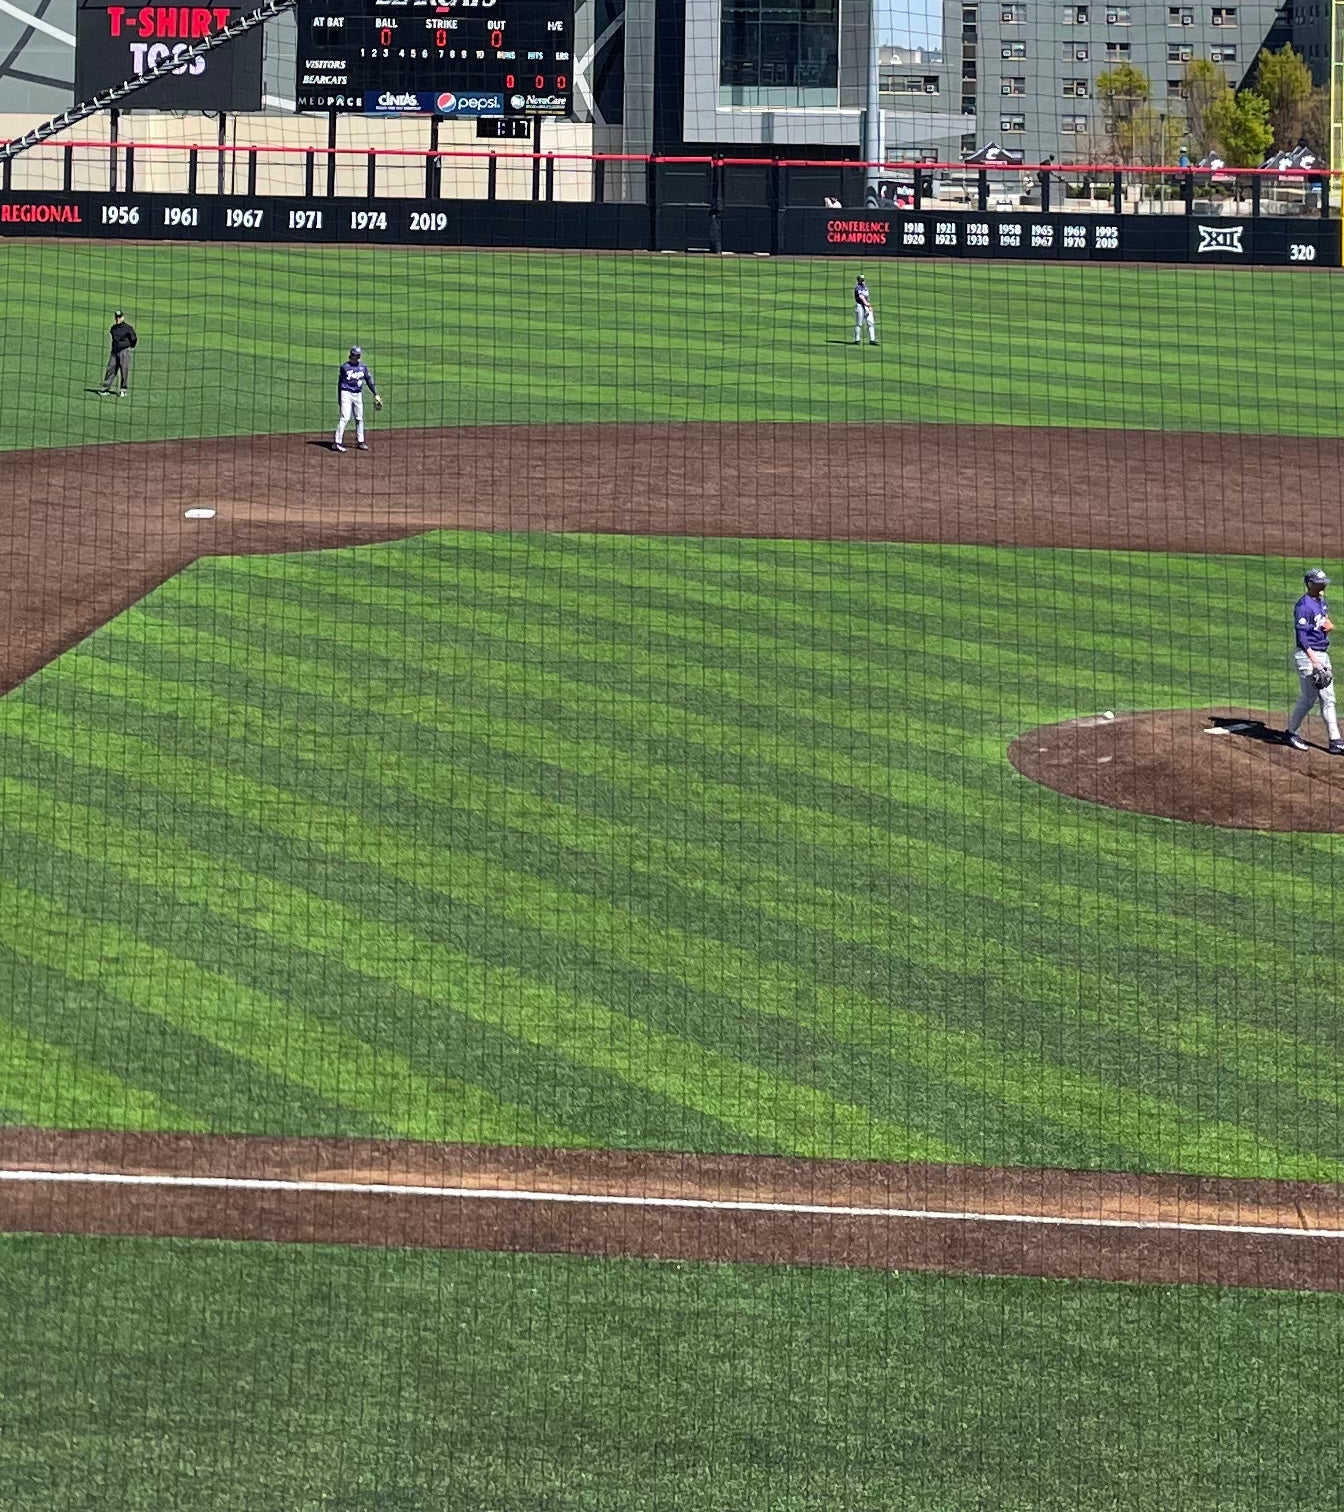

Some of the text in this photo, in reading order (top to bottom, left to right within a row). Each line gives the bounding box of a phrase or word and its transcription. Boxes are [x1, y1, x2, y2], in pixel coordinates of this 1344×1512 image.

[107, 6, 231, 38] T-SHIRT
[313, 17, 344, 28] AT BAT
[375, 18, 398, 28] BALL
[425, 19, 458, 30] STRIKE
[487, 20, 506, 30] OUT
[381, 28, 392, 46] 0
[436, 29, 447, 47] 0
[491, 31, 503, 48] 0
[305, 60, 346, 69] VISITORS
[302, 75, 348, 85] BEARCATS
[457, 96, 498, 111] pepsi
[497, 120, 529, 137] 1:17
[1, 204, 448, 231] REGIONAL 1956 1961 1967 1971 1974 2019
[827, 221, 890, 233] CONFERENCE
[936, 222, 956, 234] 1921
[967, 223, 989, 235] 1928
[999, 223, 1022, 235] 1958
[1031, 224, 1054, 236] 1965
[1063, 225, 1086, 237] 1969
[1096, 226, 1119, 237] 1995
[827, 233, 887, 244] CHAMPIONS
[903, 234, 1119, 249] 1920 1923 1930 1961 1967 1970 2019
[1290, 245, 1315, 261] 320
